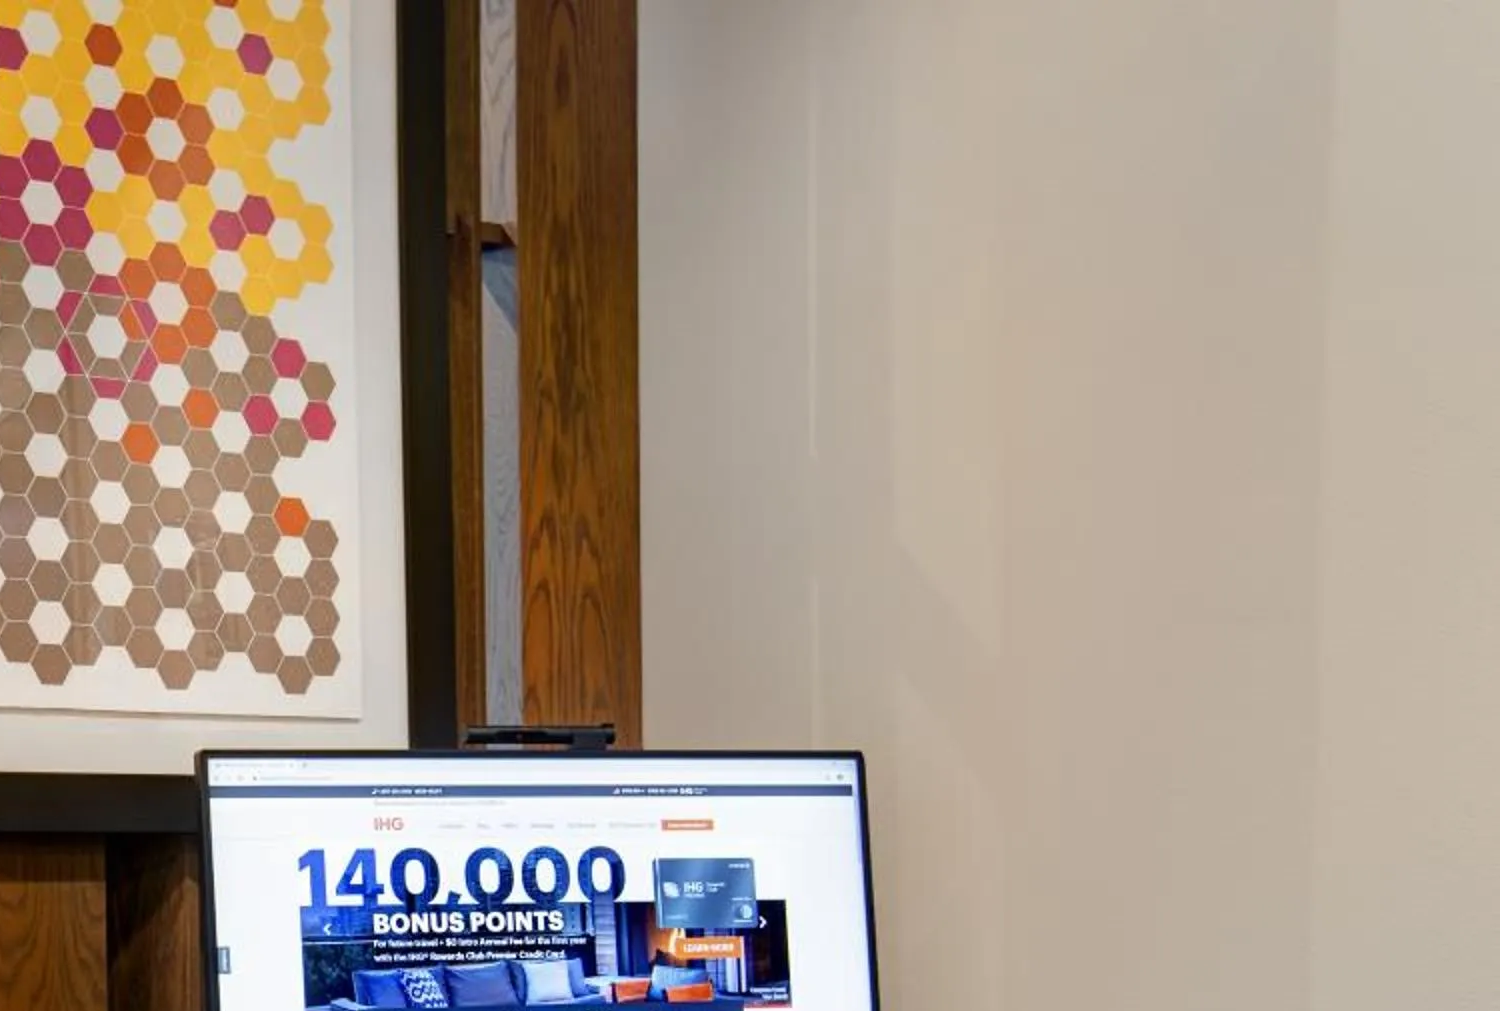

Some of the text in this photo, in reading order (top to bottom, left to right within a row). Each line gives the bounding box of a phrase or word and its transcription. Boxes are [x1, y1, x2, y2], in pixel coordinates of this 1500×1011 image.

[373, 817, 405, 831] IHG
[297, 846, 626, 906] 140,000
[683, 881, 705, 893] IHG
[372, 910, 565, 934] BONUS POINTS
[373, 939, 386, 948] For
[480, 937, 508, 946] Annual
[509, 937, 522, 945] Fee
[569, 937, 587, 946] year
[373, 953, 392, 962] with
[430, 951, 464, 961] Rewards
[466, 951, 485, 960] Club
[486, 950, 516, 960] Premier
[519, 949, 544, 959] Credit
